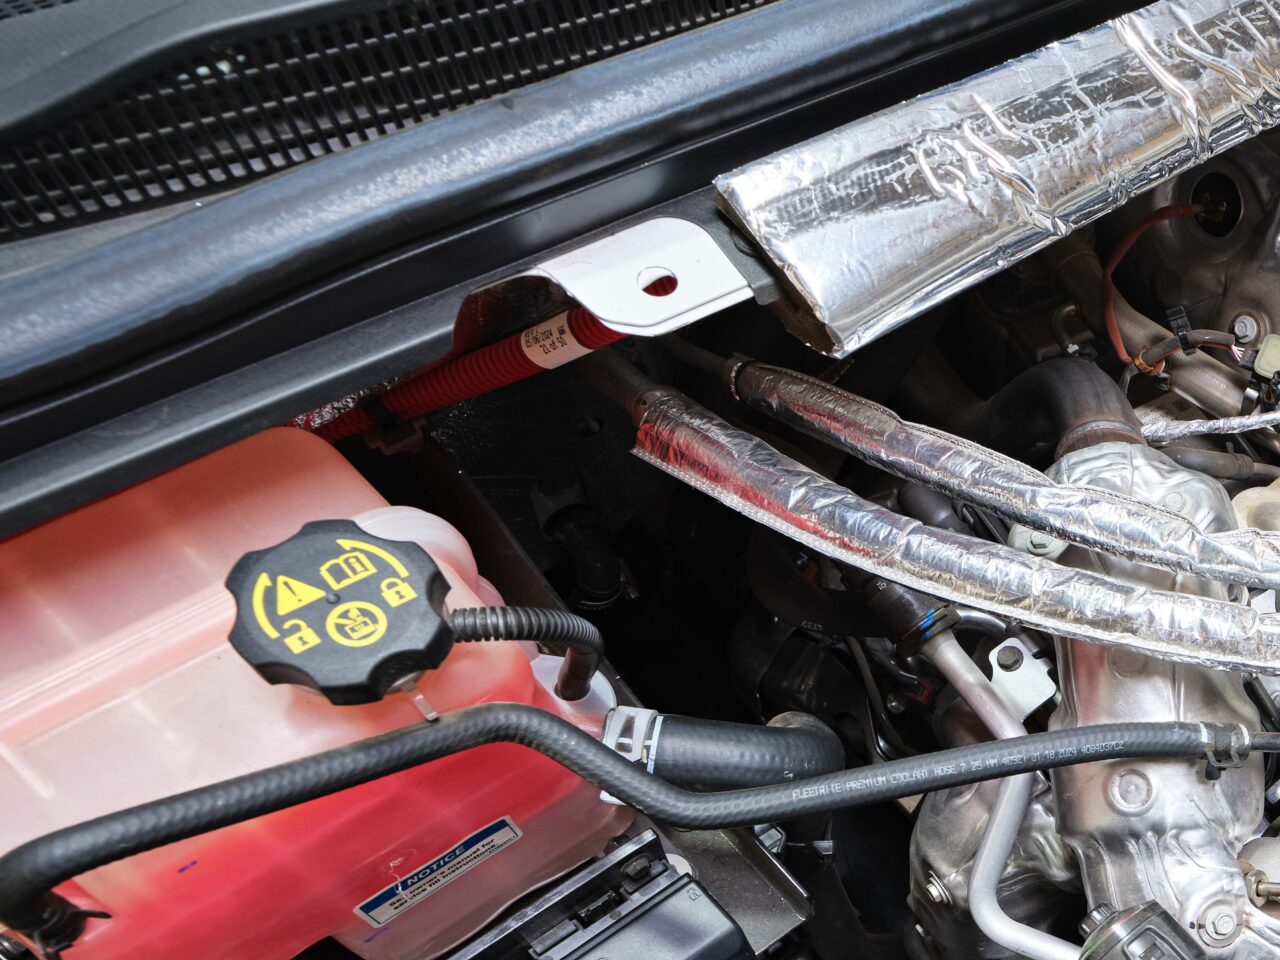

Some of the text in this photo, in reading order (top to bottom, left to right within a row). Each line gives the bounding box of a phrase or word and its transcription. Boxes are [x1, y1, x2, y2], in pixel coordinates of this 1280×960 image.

[539, 336, 568, 354] 21 of 50
[792, 784, 842, 800] FLEETRITE
[847, 776, 887, 791] PREMIUM
[890, 769, 929, 784] COOLANT
[934, 763, 957, 776] HOSE
[986, 757, 999, 769] MM
[407, 846, 466, 886] NOTICE
[409, 870, 446, 894] owner's
[447, 847, 481, 870] manual
[481, 838, 495, 849] for
[393, 888, 428, 910] service
[428, 877, 441, 887] fill
